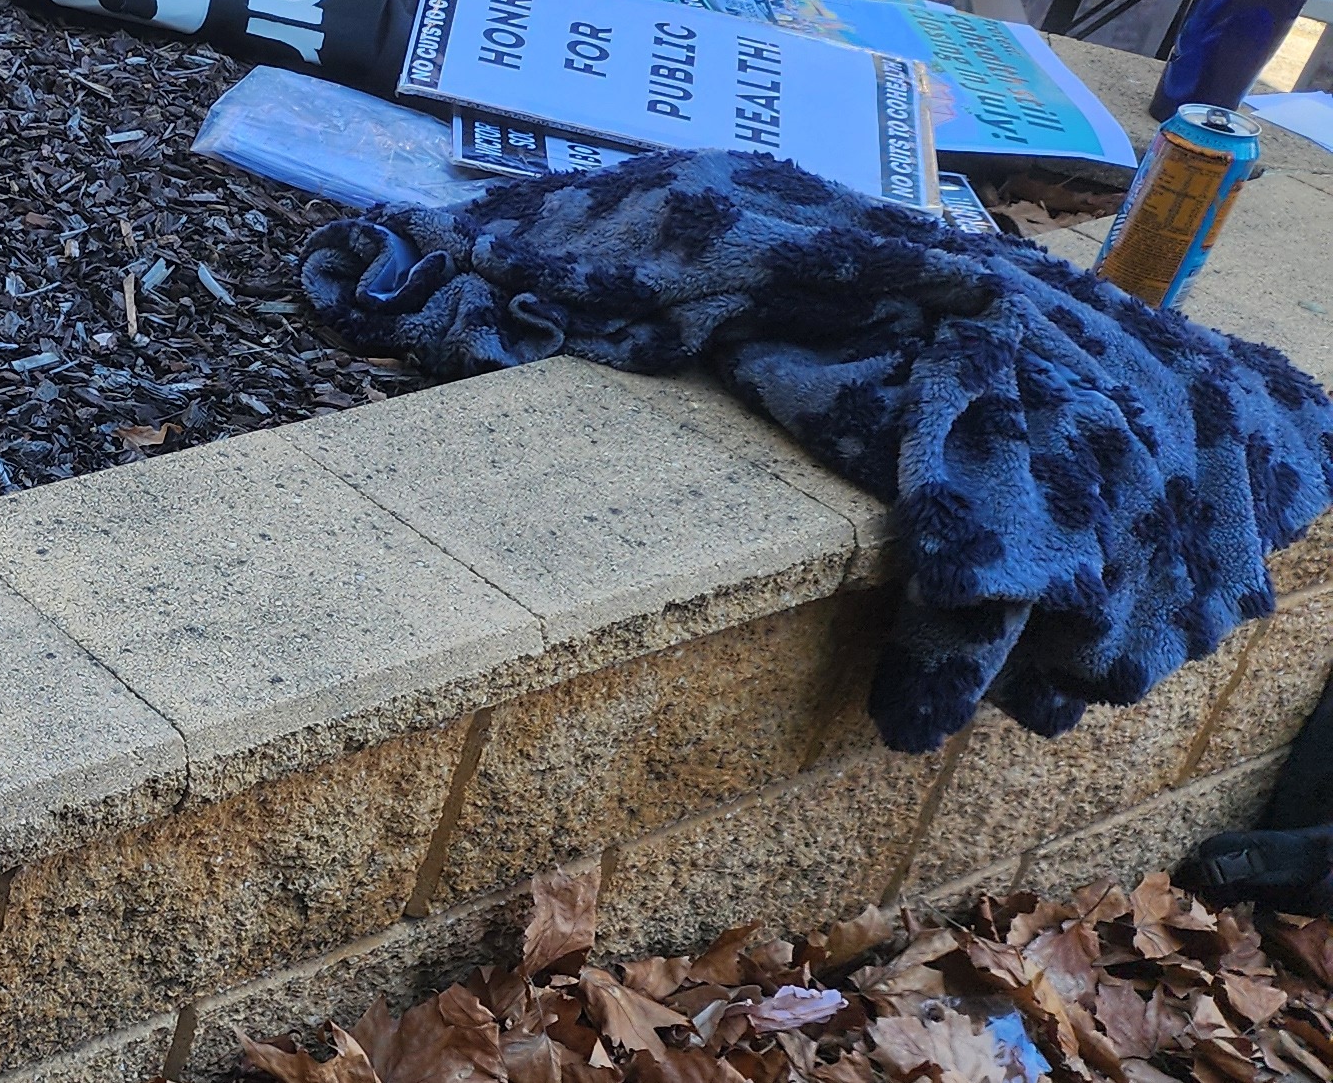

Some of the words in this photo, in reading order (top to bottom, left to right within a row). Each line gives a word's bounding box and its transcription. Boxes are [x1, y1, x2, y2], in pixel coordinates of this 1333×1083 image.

[423, 9, 446, 26] TO
[416, 29, 442, 59] CUTS
[563, 21, 613, 78] FOR
[410, 59, 433, 82] NO
[646, 22, 697, 122] PUBLIC
[944, 12, 1030, 85] cohealth
[1006, 86, 1066, 132] still
[955, 67, 992, 85] in
[735, 35, 782, 149] HEALTH!
[887, 120, 910, 138] TO
[959, 81, 1029, 145] July!
[889, 139, 914, 174] CUTS
[891, 175, 915, 199] NO
